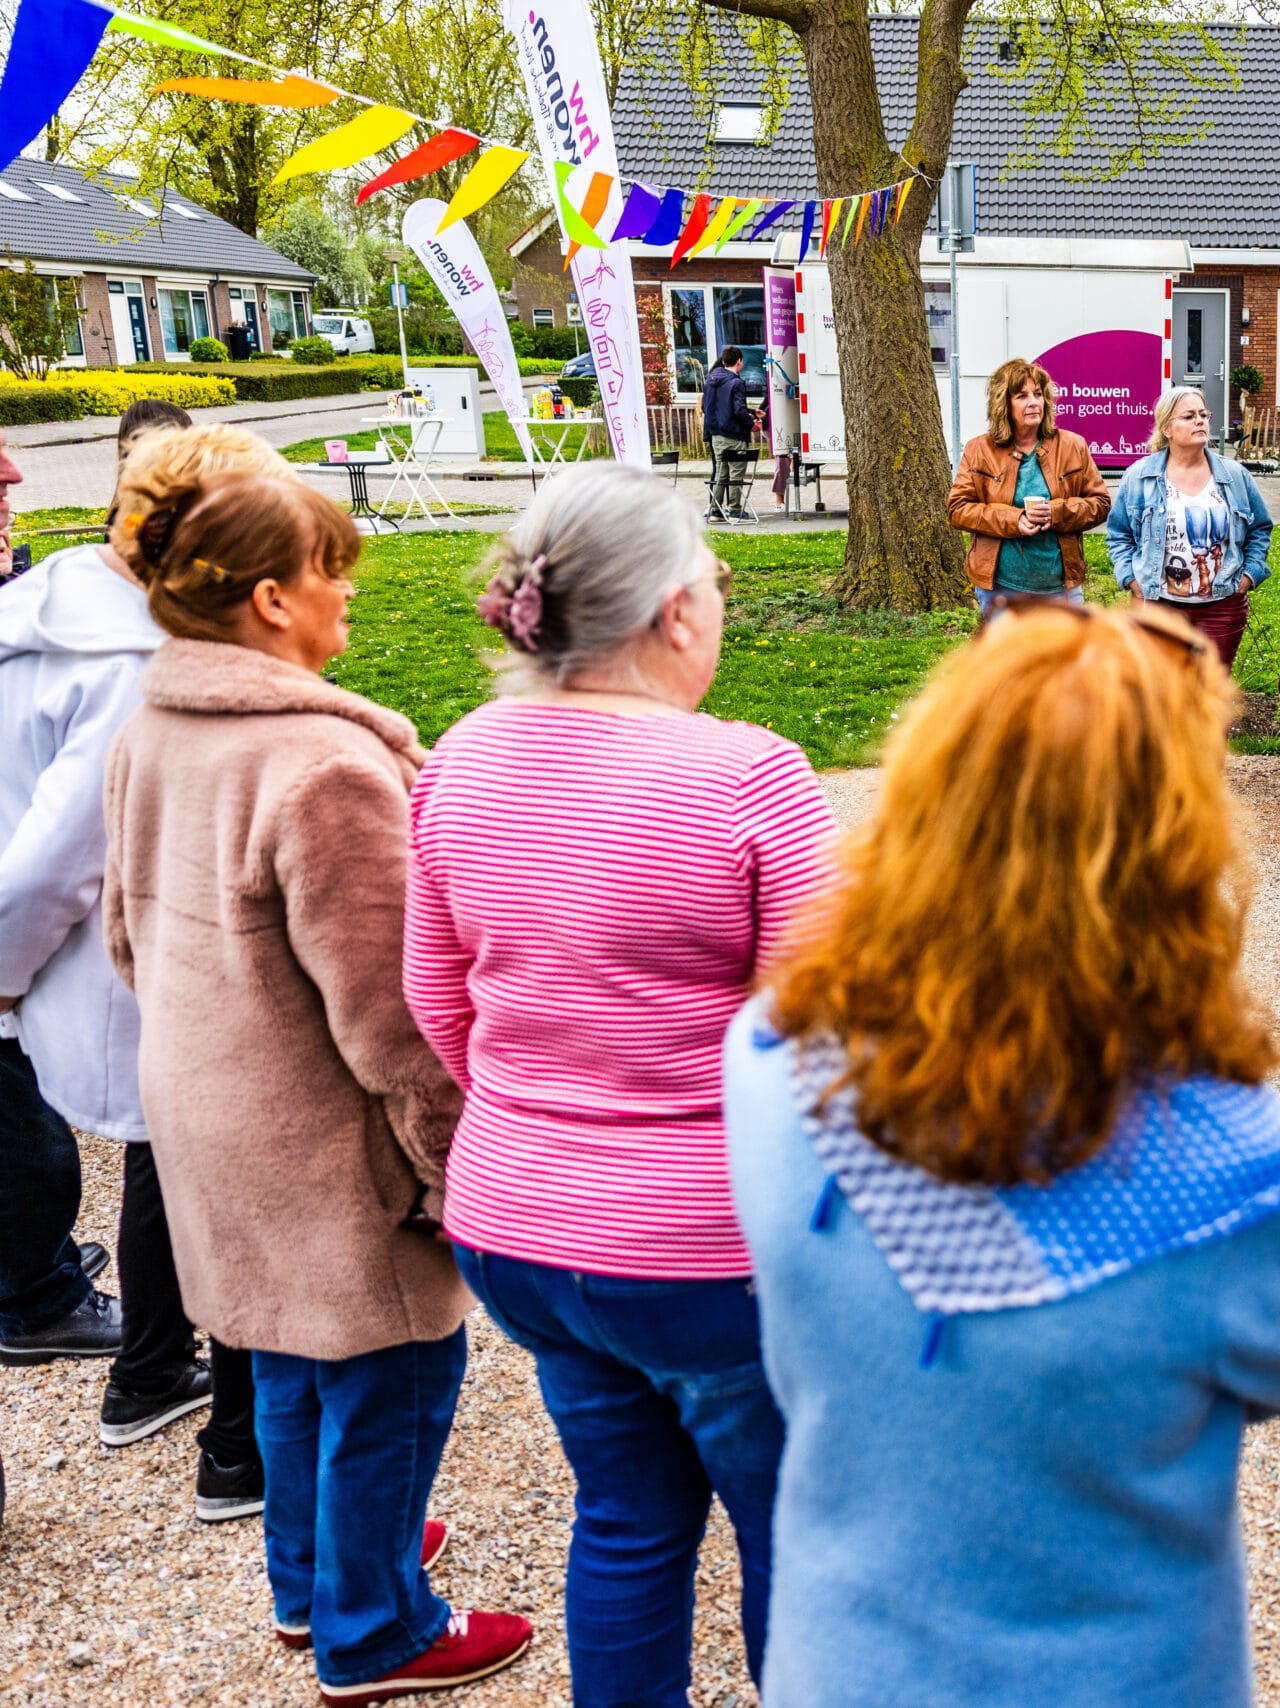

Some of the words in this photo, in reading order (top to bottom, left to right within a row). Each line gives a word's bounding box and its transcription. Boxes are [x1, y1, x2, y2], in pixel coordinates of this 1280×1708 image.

[1072, 383, 1130, 398] bouwen
[1078, 401, 1112, 418] goed
[1116, 401, 1154, 415] thuis.
